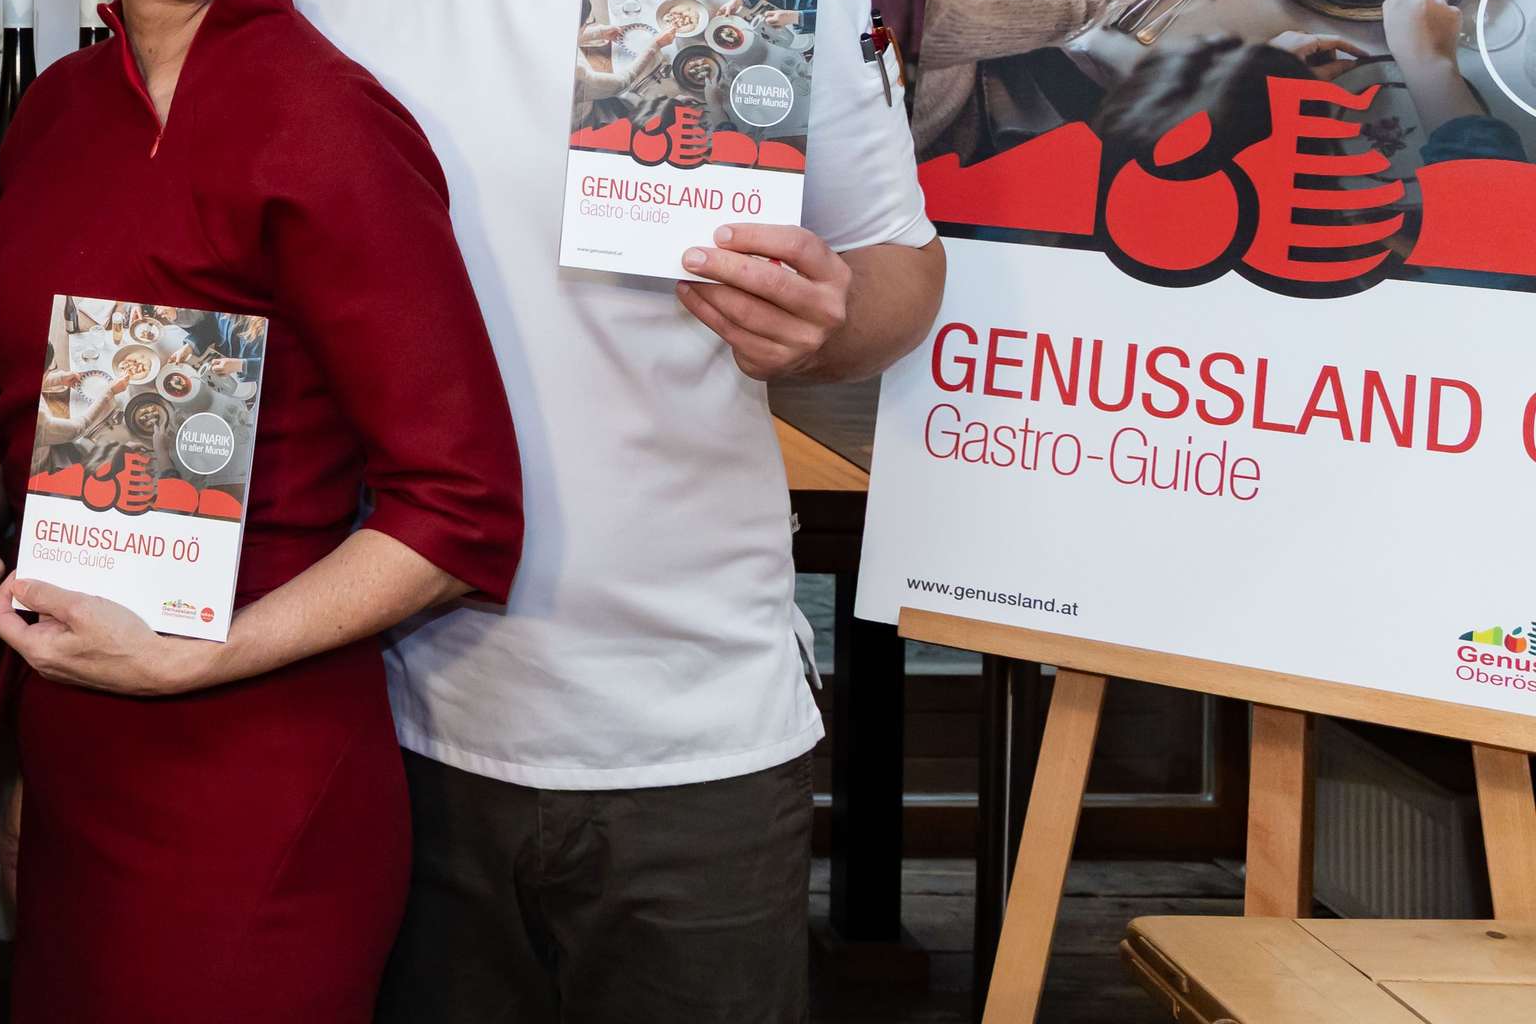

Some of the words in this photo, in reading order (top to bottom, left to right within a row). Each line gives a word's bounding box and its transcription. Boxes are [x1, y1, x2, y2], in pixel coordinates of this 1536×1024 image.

[736, 83, 790, 98] KULINARIK
[581, 175, 724, 211] GENUSSLAND
[731, 189, 762, 215] OÖ
[579, 199, 671, 224] Gastro-Guide
[930, 322, 1483, 454] GENUSSLAND
[181, 430, 231, 447] KULINARIK
[924, 403, 1262, 501] Gastro-Guide
[35, 520, 166, 558] GENUSSLAND
[172, 536, 201, 563] OÖ
[32, 542, 115, 570] Gastro-Guide
[906, 577, 1080, 617] www.genussland.at
[1457, 645, 1536, 673] Genu
[1456, 665, 1536, 693] Oberös
